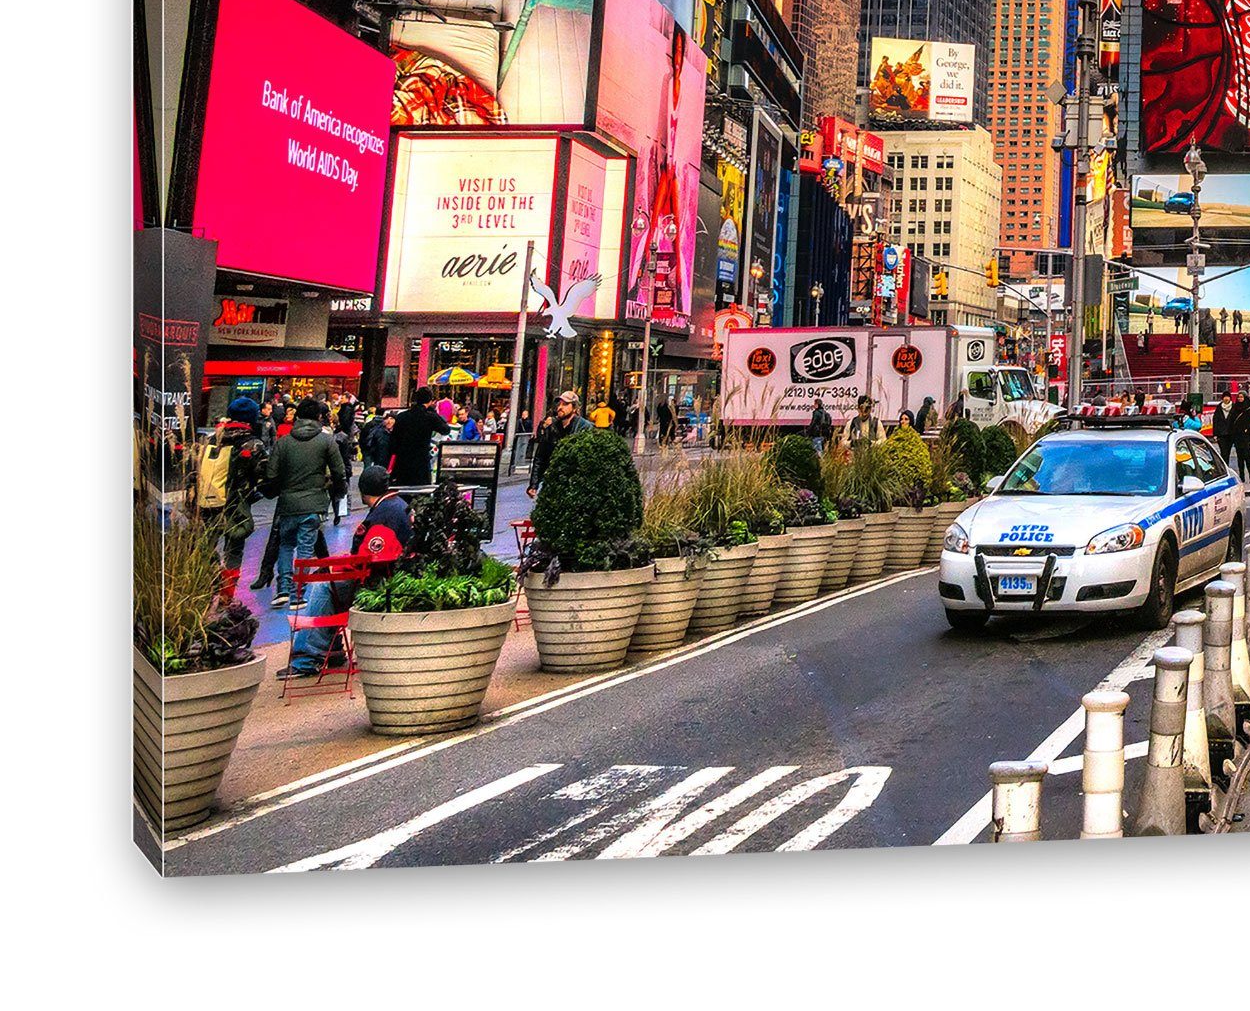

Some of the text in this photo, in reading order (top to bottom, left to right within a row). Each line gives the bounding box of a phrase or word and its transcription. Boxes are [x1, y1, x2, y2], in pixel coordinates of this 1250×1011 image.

[948, 47, 960, 59] By
[936, 57, 970, 71] George,
[946, 71, 959, 79] we
[940, 79, 964, 90] did it.
[262, 80, 385, 156] Bank of America recognizes
[288, 138, 359, 193] World AIDS Day.
[459, 177, 516, 192] VISIT US
[437, 195, 535, 211] INSIDE ON THE
[452, 214, 516, 229] 3RD LEVEL
[441, 244, 518, 278] aerie
[250, 328, 279, 337] MARQUIS
[1051, 337, 1066, 367] tkts
[803, 349, 844, 371] edge
[784, 386, 859, 399] (212) 947-3343
[1010, 524, 1049, 532] NYPD
[999, 532, 1055, 543] POLICE
[1000, 577, 1026, 591] 4135
